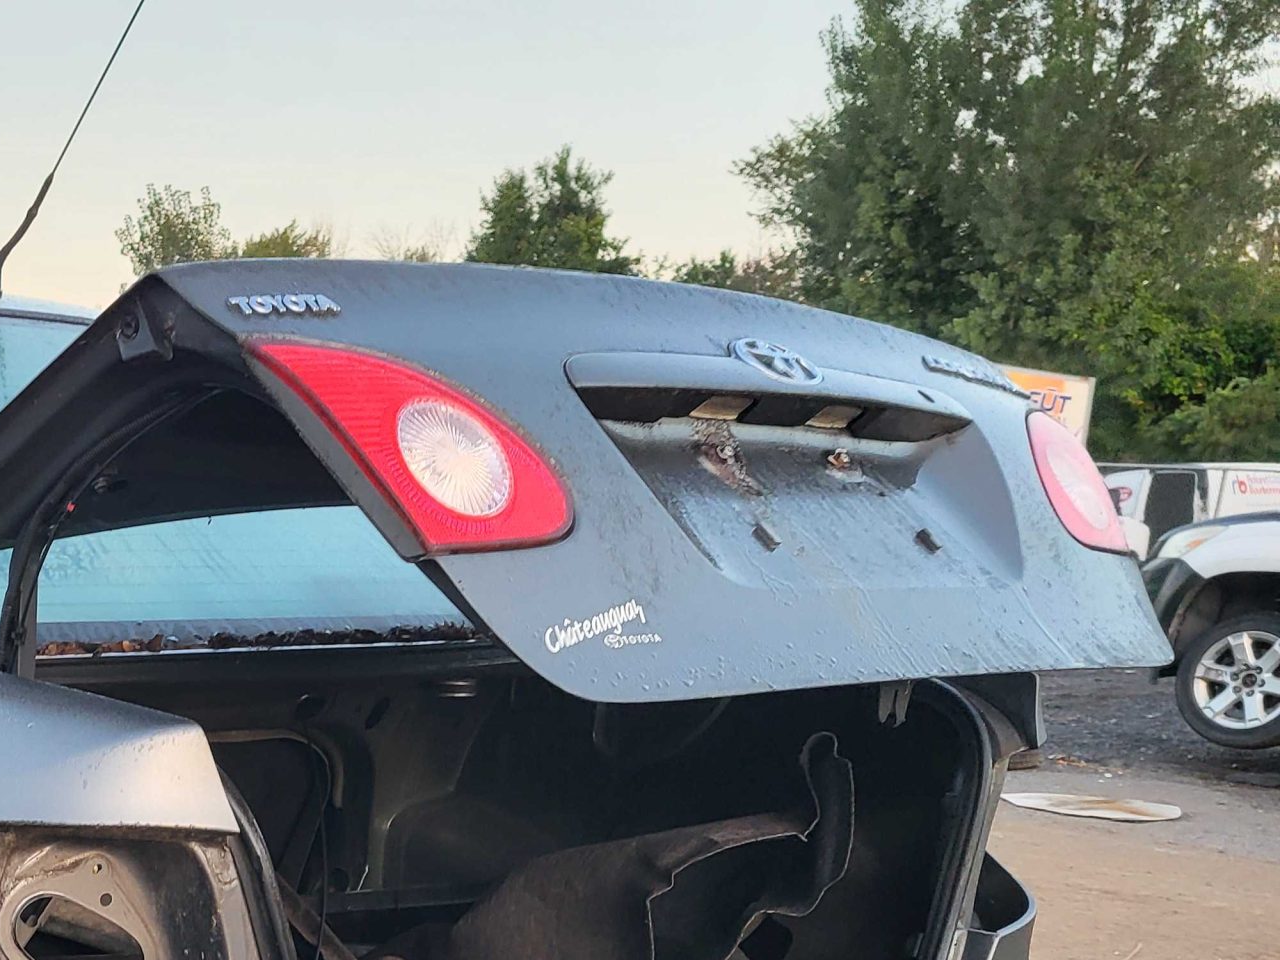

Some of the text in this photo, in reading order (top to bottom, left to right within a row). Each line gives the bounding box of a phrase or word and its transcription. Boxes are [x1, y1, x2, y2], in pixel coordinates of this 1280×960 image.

[227, 294, 342, 316] TOYOTA
[544, 598, 646, 654] Châteauguay
[621, 633, 663, 646] TOYOTA
